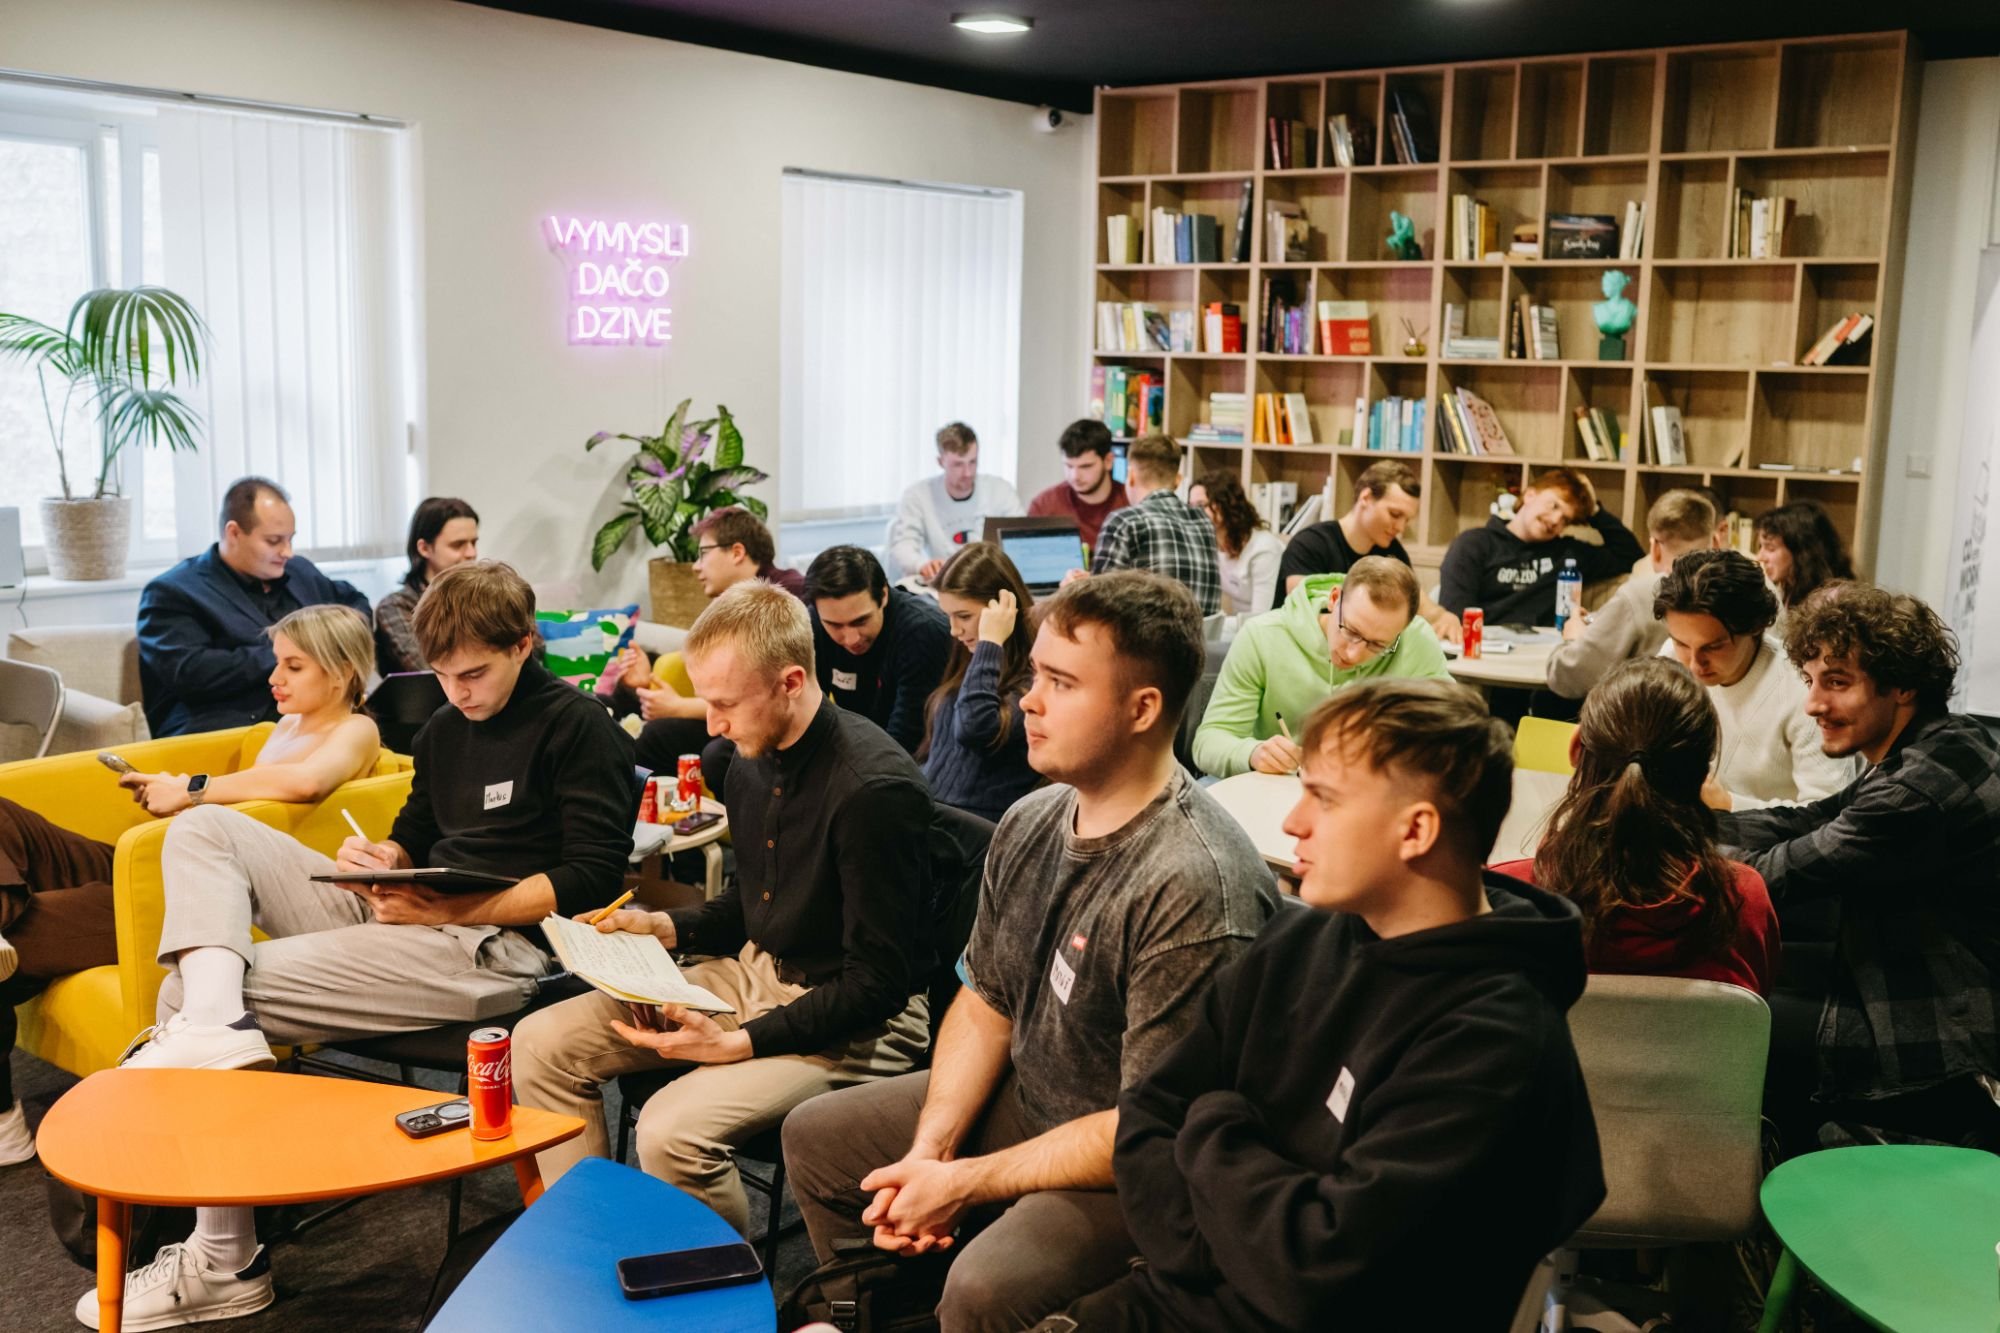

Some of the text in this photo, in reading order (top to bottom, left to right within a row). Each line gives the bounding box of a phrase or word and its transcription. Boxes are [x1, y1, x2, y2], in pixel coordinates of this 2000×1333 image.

[550, 215, 689, 257] VYMYSLI
[578, 257, 670, 297] DAČO
[577, 305, 673, 341] DZIVE
